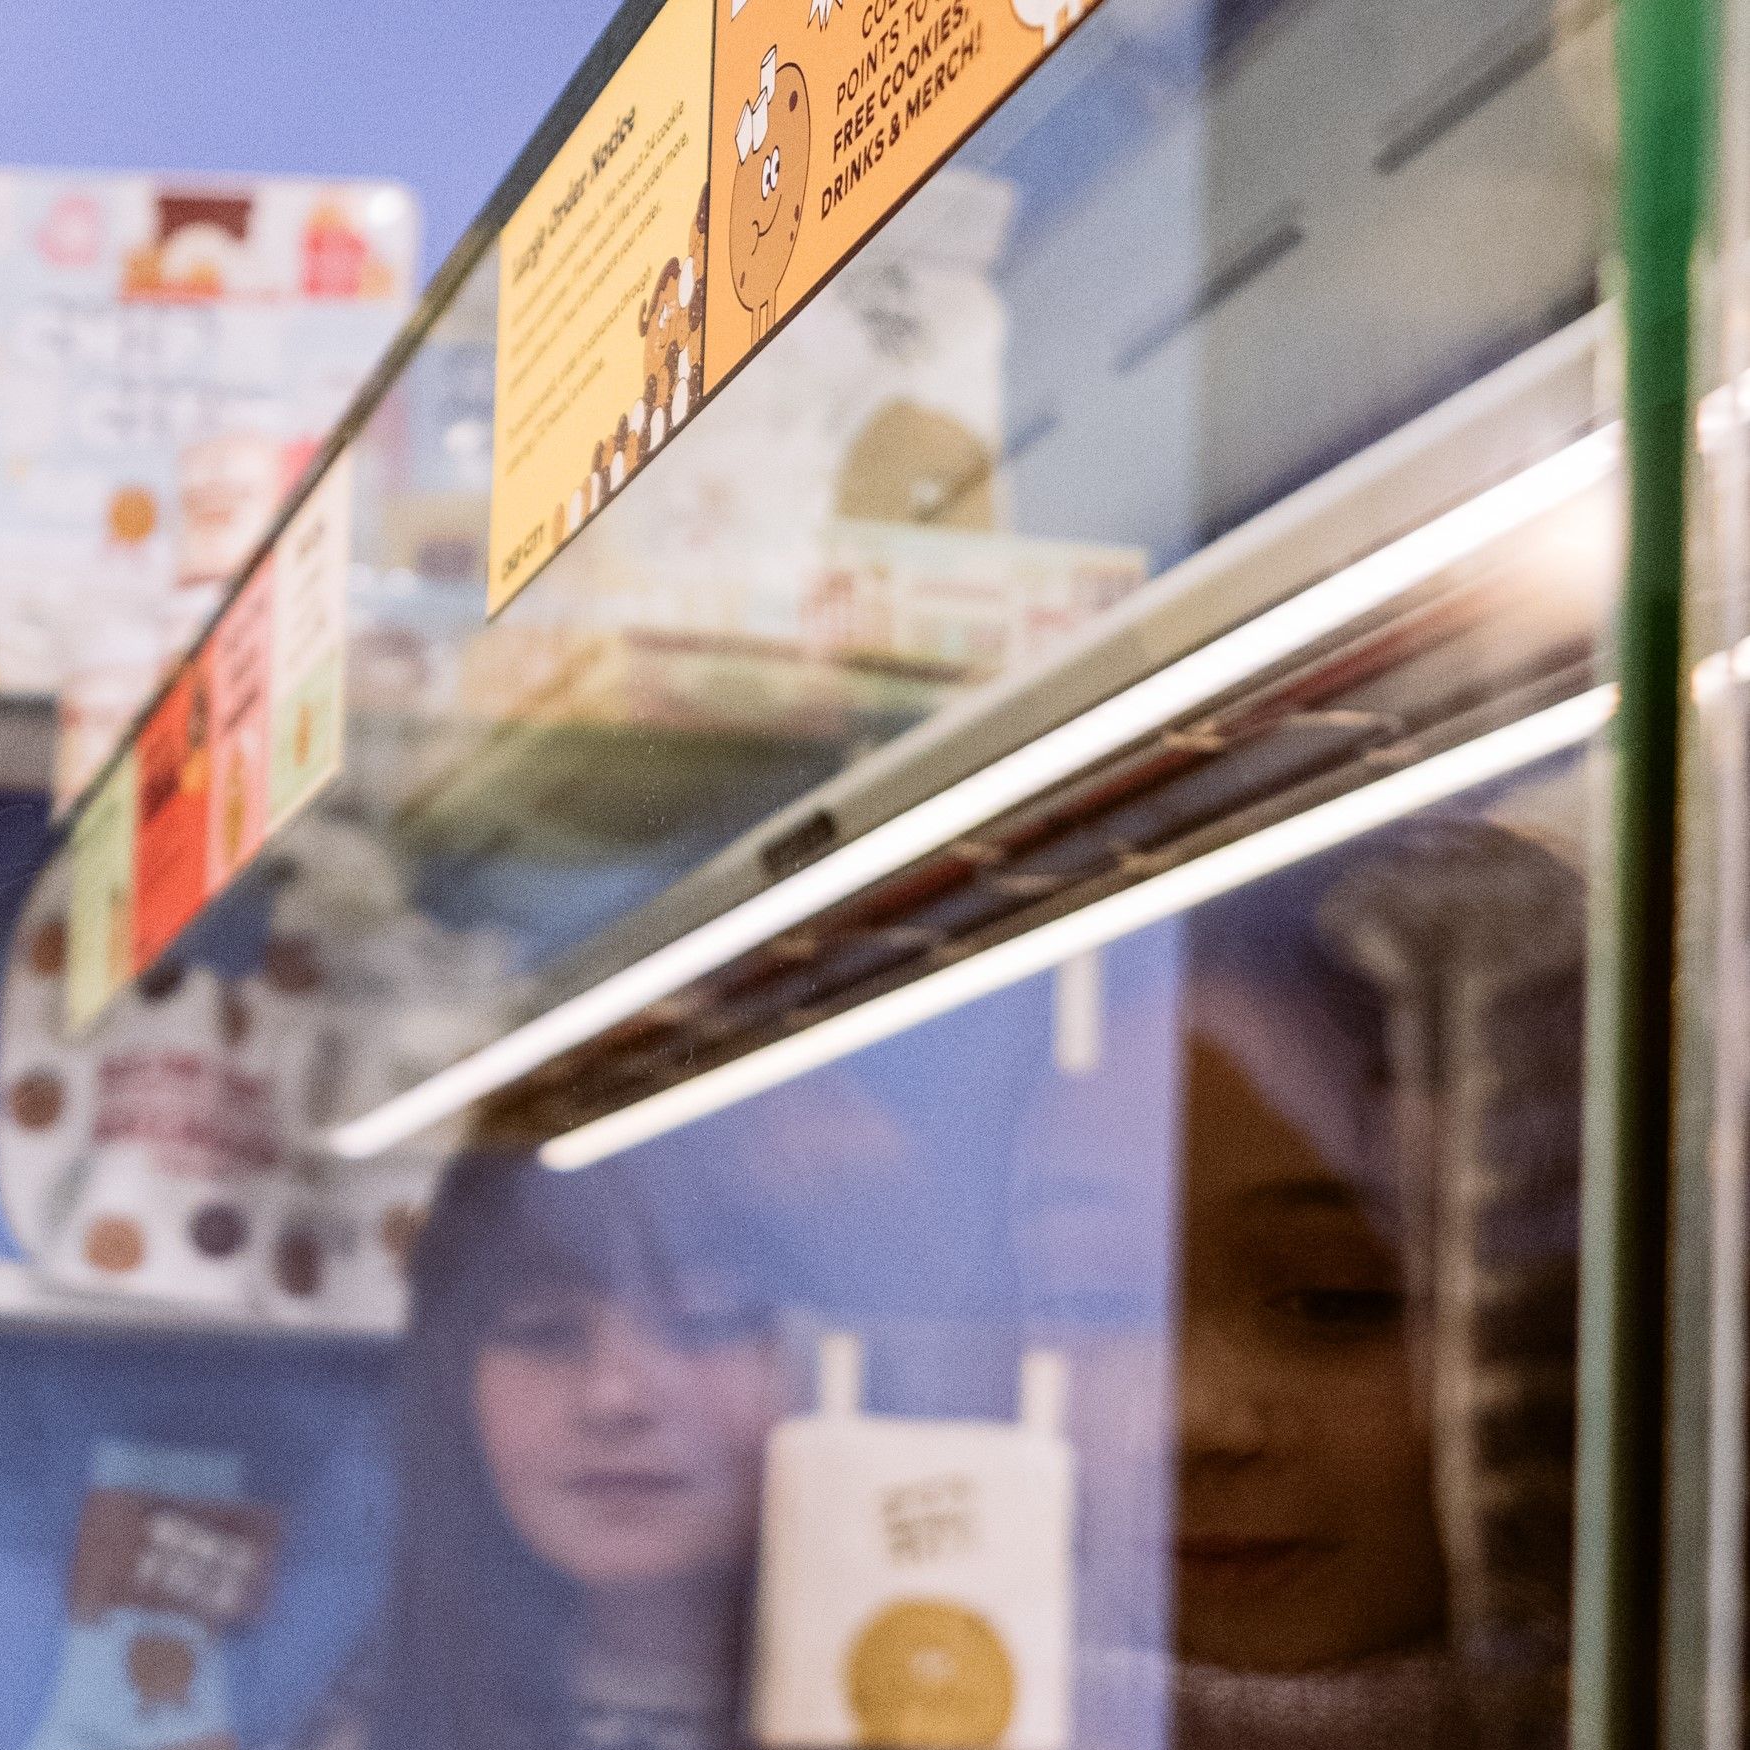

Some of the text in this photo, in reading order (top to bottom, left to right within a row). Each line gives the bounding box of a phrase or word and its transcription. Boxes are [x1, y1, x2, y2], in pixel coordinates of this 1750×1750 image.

[833, 0, 969, 164] FREE COOKIES,
[837, 0, 927, 116] POINTS TO
[640, 160, 664, 197] order
[664, 132, 689, 168] more,
[642, 134, 656, 164] 24
[655, 100, 684, 144] cookie
[821, 21, 982, 220] DRINKS & MERCH!
[513, 225, 546, 285] Large
[548, 171, 588, 238] Order
[590, 106, 637, 184] Notice
[619, 265, 652, 313] through
